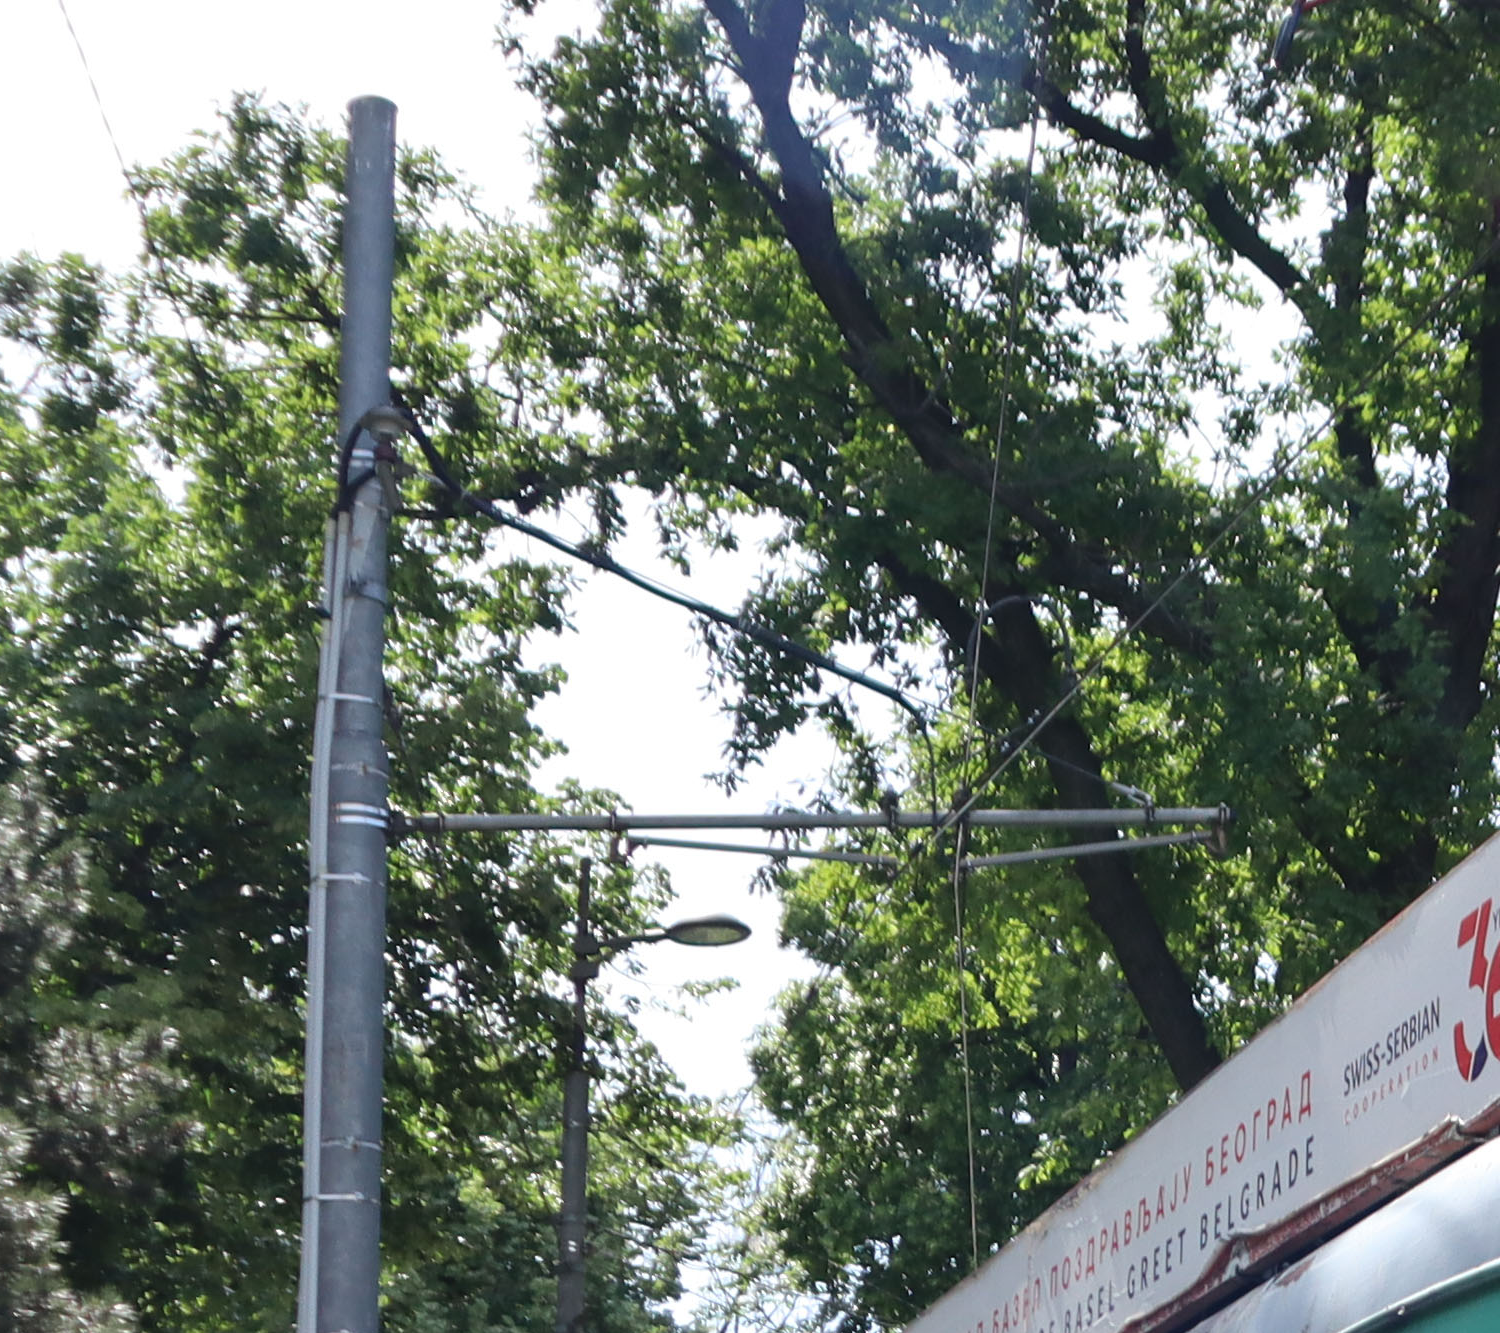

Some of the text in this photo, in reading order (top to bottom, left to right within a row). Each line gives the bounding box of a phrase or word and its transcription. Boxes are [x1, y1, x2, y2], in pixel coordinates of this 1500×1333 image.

[1343, 996, 1441, 1097] SWISS-SERBIAN
[1343, 1046, 1440, 1126] COOPERATION
[1049, 1162, 1192, 1298] ПОЗДРАВЉАЈУ
[1205, 1069, 1312, 1187] БЕОГРАД
[1126, 1227, 1187, 1300] GREET
[1200, 1134, 1315, 1251] BELGRADE
